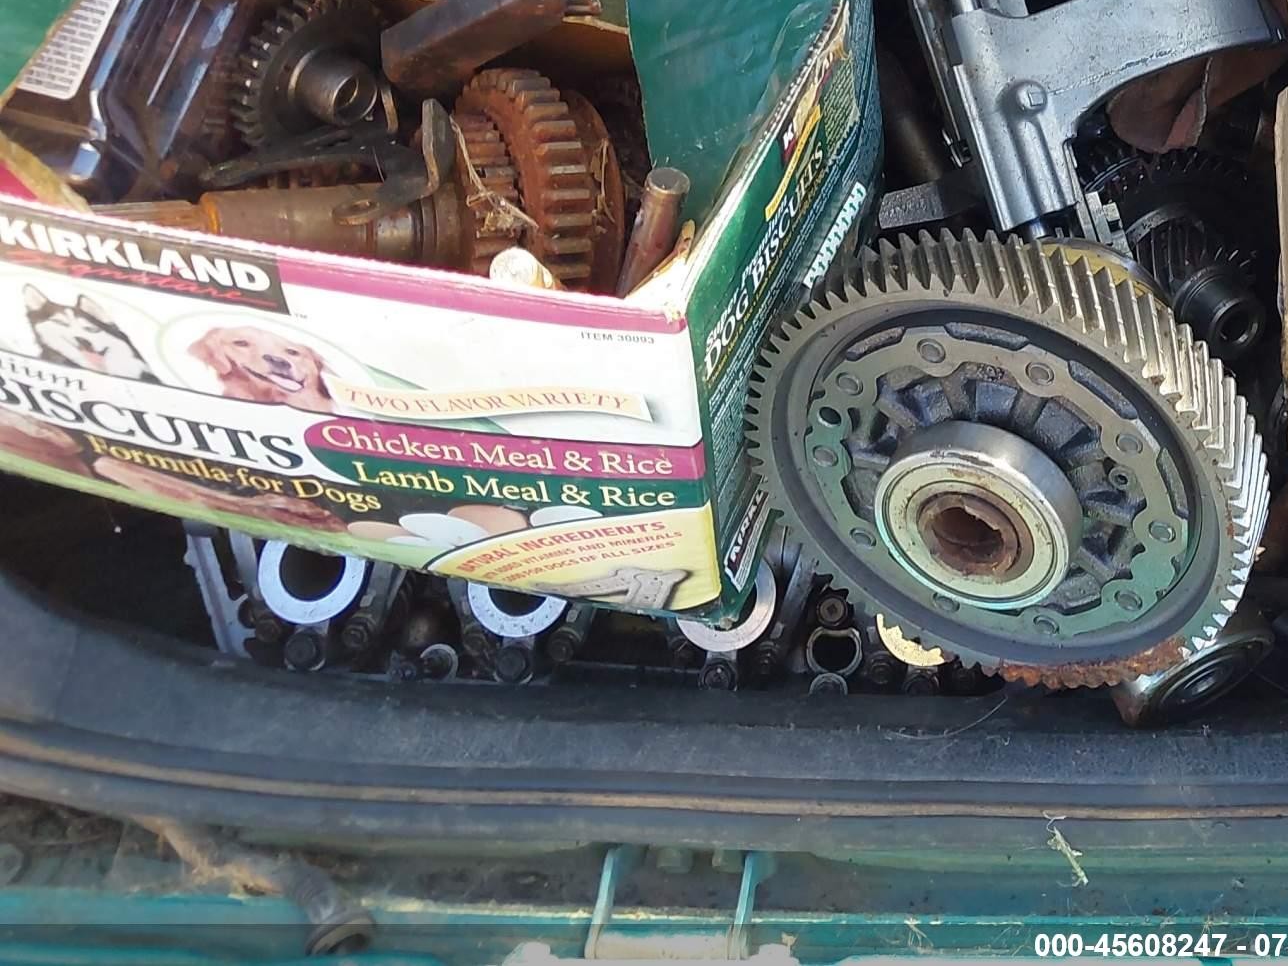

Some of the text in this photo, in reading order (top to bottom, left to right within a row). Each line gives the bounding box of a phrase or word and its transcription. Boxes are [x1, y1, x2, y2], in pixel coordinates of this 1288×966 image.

[0, 214, 271, 292] KIRKLAND
[703, 289, 751, 382] DOG
[750, 141, 826, 293] BISCUITS
[704, 195, 788, 347] Super Premium
[580, 331, 656, 345] ITEM 30093
[345, 388, 630, 414] TWO FLAVOR VARIETY
[86, 434, 231, 483] Formula
[291, 478, 382, 513] Dogs
[321, 425, 674, 476] Chicken Meal & Rice
[352, 461, 675, 507] Lamb Meal & Rice
[516, 521, 667, 552] INGREDIENTS
[546, 559, 580, 574] DOGS
[580, 554, 598, 565] OF
[602, 549, 630, 561] ALL
[632, 541, 676, 554] SIZES
[578, 542, 607, 553] AND
[608, 531, 683, 548] MINERALS
